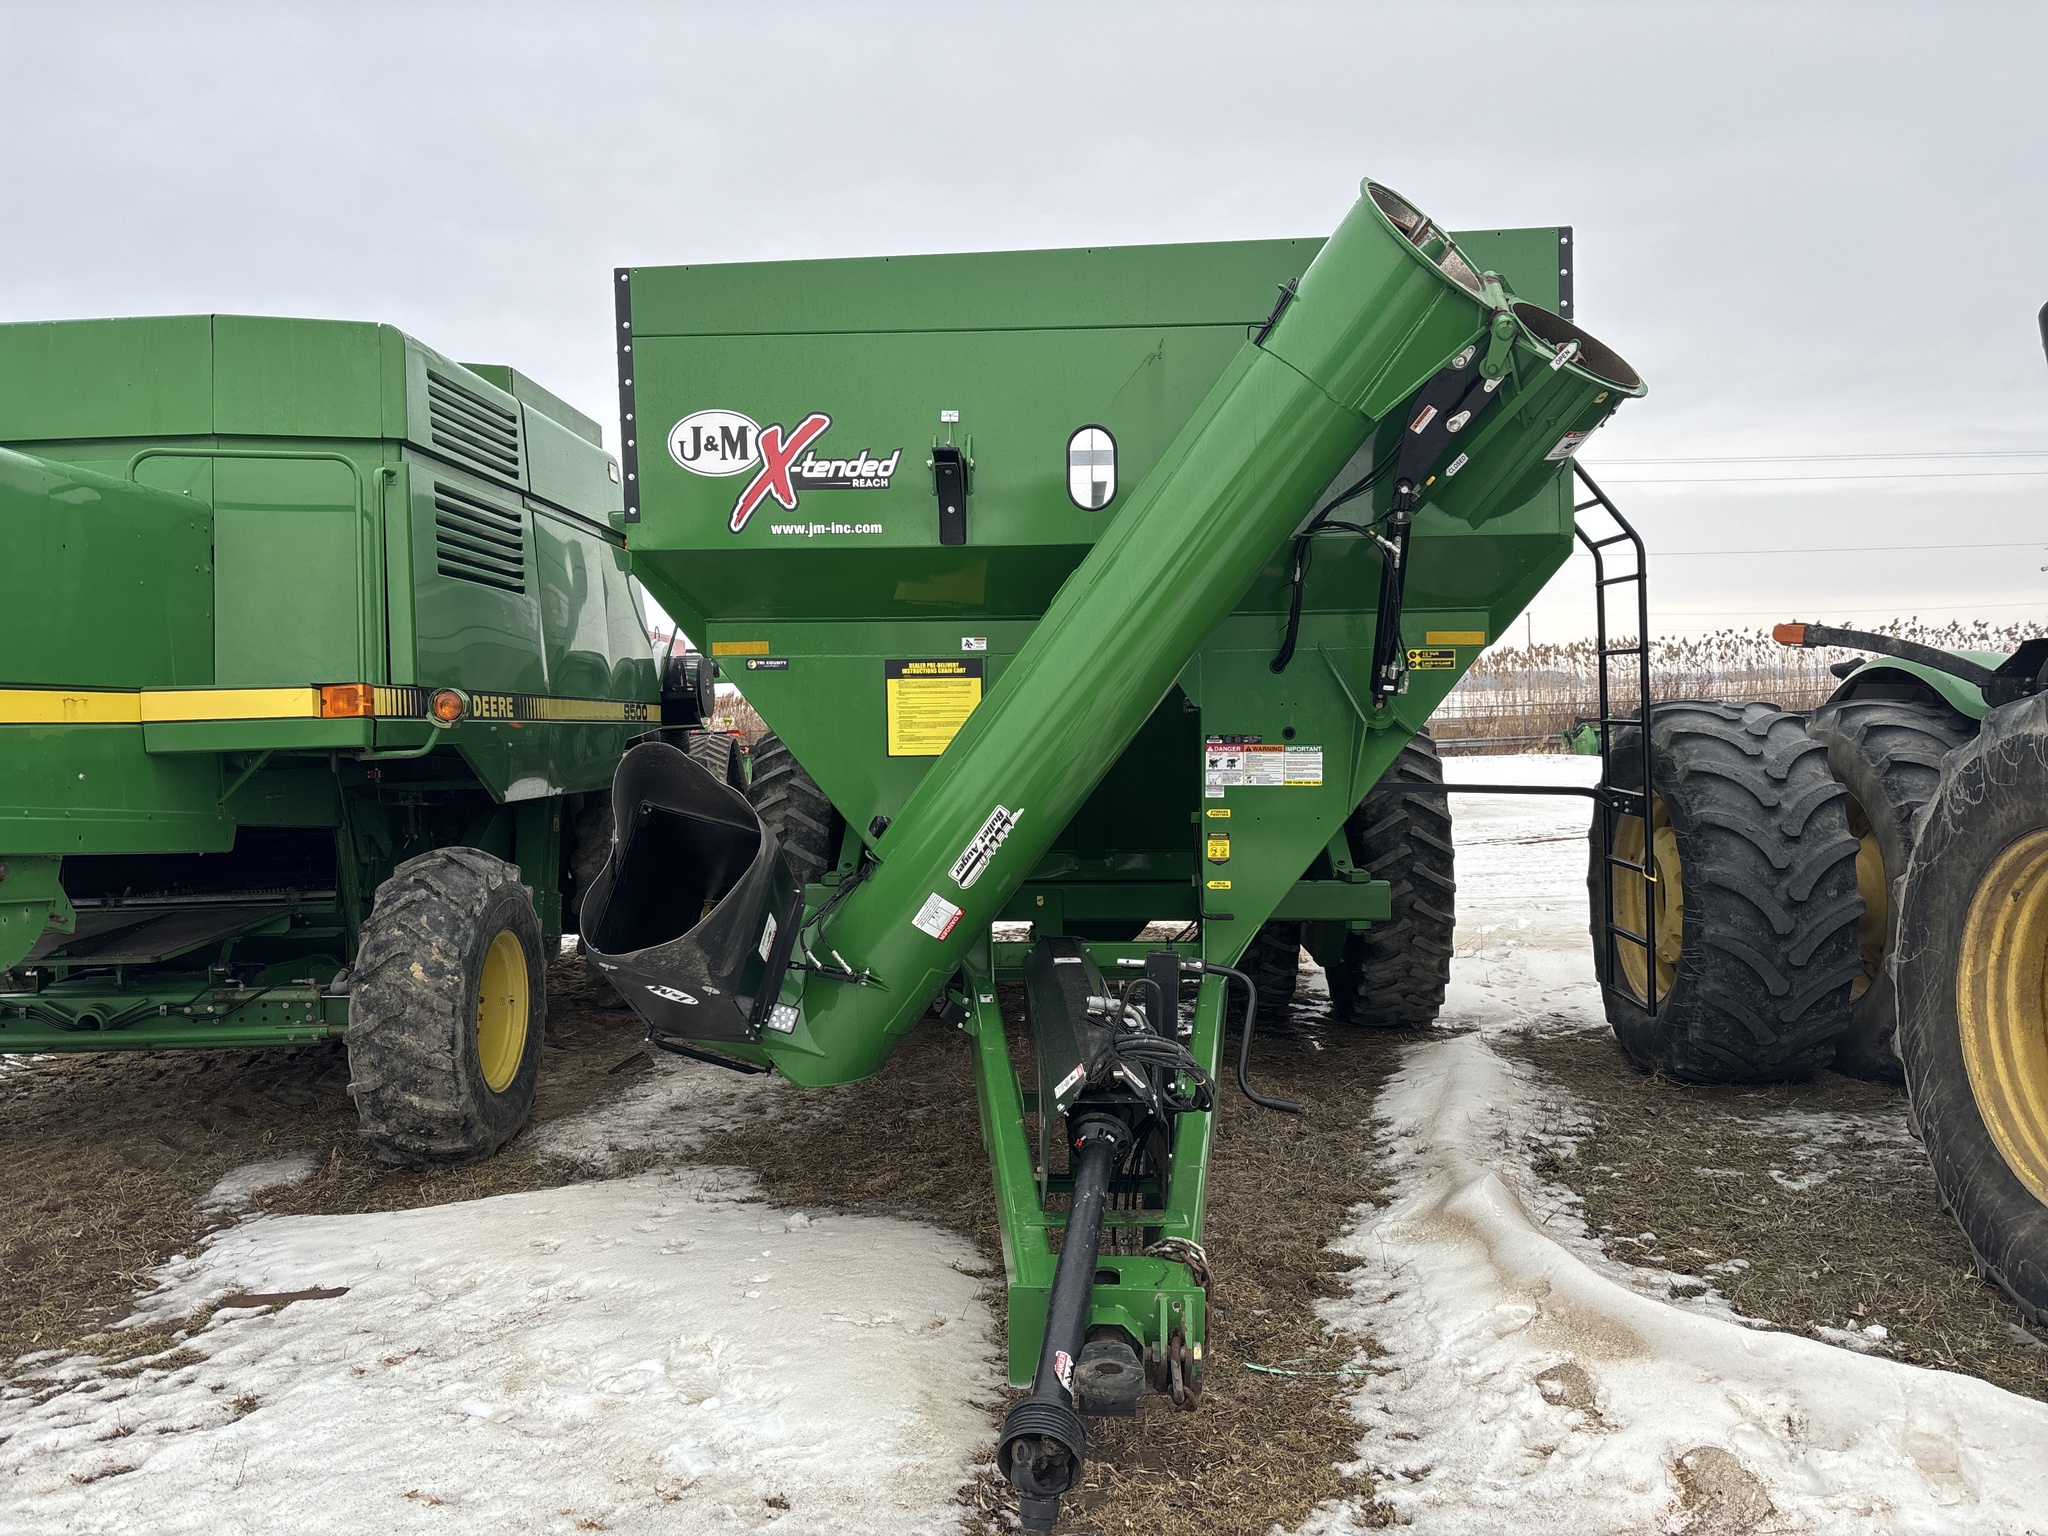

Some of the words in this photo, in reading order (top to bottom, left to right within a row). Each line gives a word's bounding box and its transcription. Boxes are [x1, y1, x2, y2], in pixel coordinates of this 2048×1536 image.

[1555, 349, 1571, 366] OPEN
[1447, 454, 1467, 475] CLOSED
[852, 478, 889, 488] REACH
[770, 521, 883, 538] www.jm-inc.com
[472, 694, 515, 718] DEERE
[623, 703, 648, 721] 9500
[978, 809, 1004, 844] Bullet
[955, 842, 979, 877] Auger
[938, 915, 960, 941] DANGER
